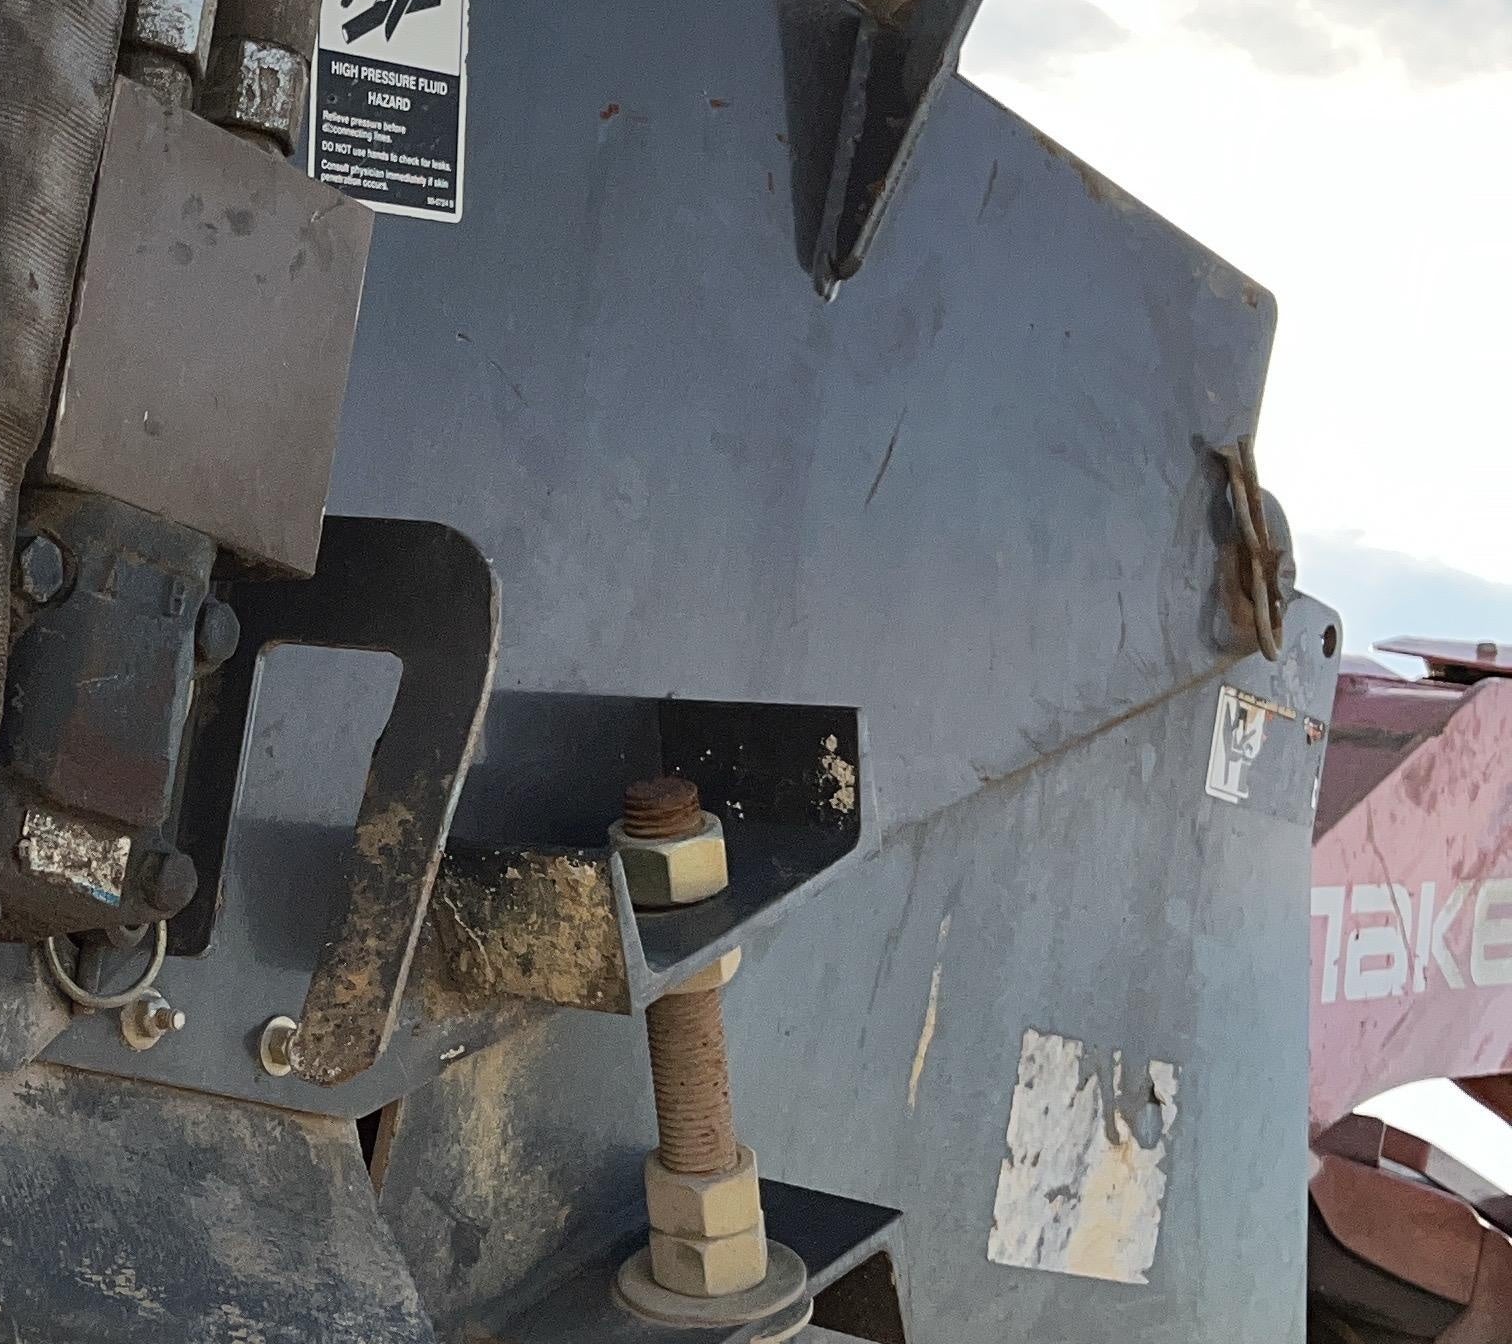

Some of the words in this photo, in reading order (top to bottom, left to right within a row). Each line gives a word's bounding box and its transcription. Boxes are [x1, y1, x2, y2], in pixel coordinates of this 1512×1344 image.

[331, 60, 359, 78] HIGH
[361, 66, 417, 90] PRESSURE
[418, 77, 448, 96] FLUID
[368, 91, 411, 111] HAZARD
[322, 110, 350, 124] Relieve
[350, 117, 382, 130] pressure
[383, 122, 407, 135] before
[321, 140, 334, 152] DO
[335, 143, 352, 154] NOT
[352, 148, 367, 157] use
[367, 148, 389, 161] hands
[390, 153, 398, 163] to
[399, 154, 420, 166] check
[420, 157, 431, 168] for
[321, 159, 350, 173] Consult
